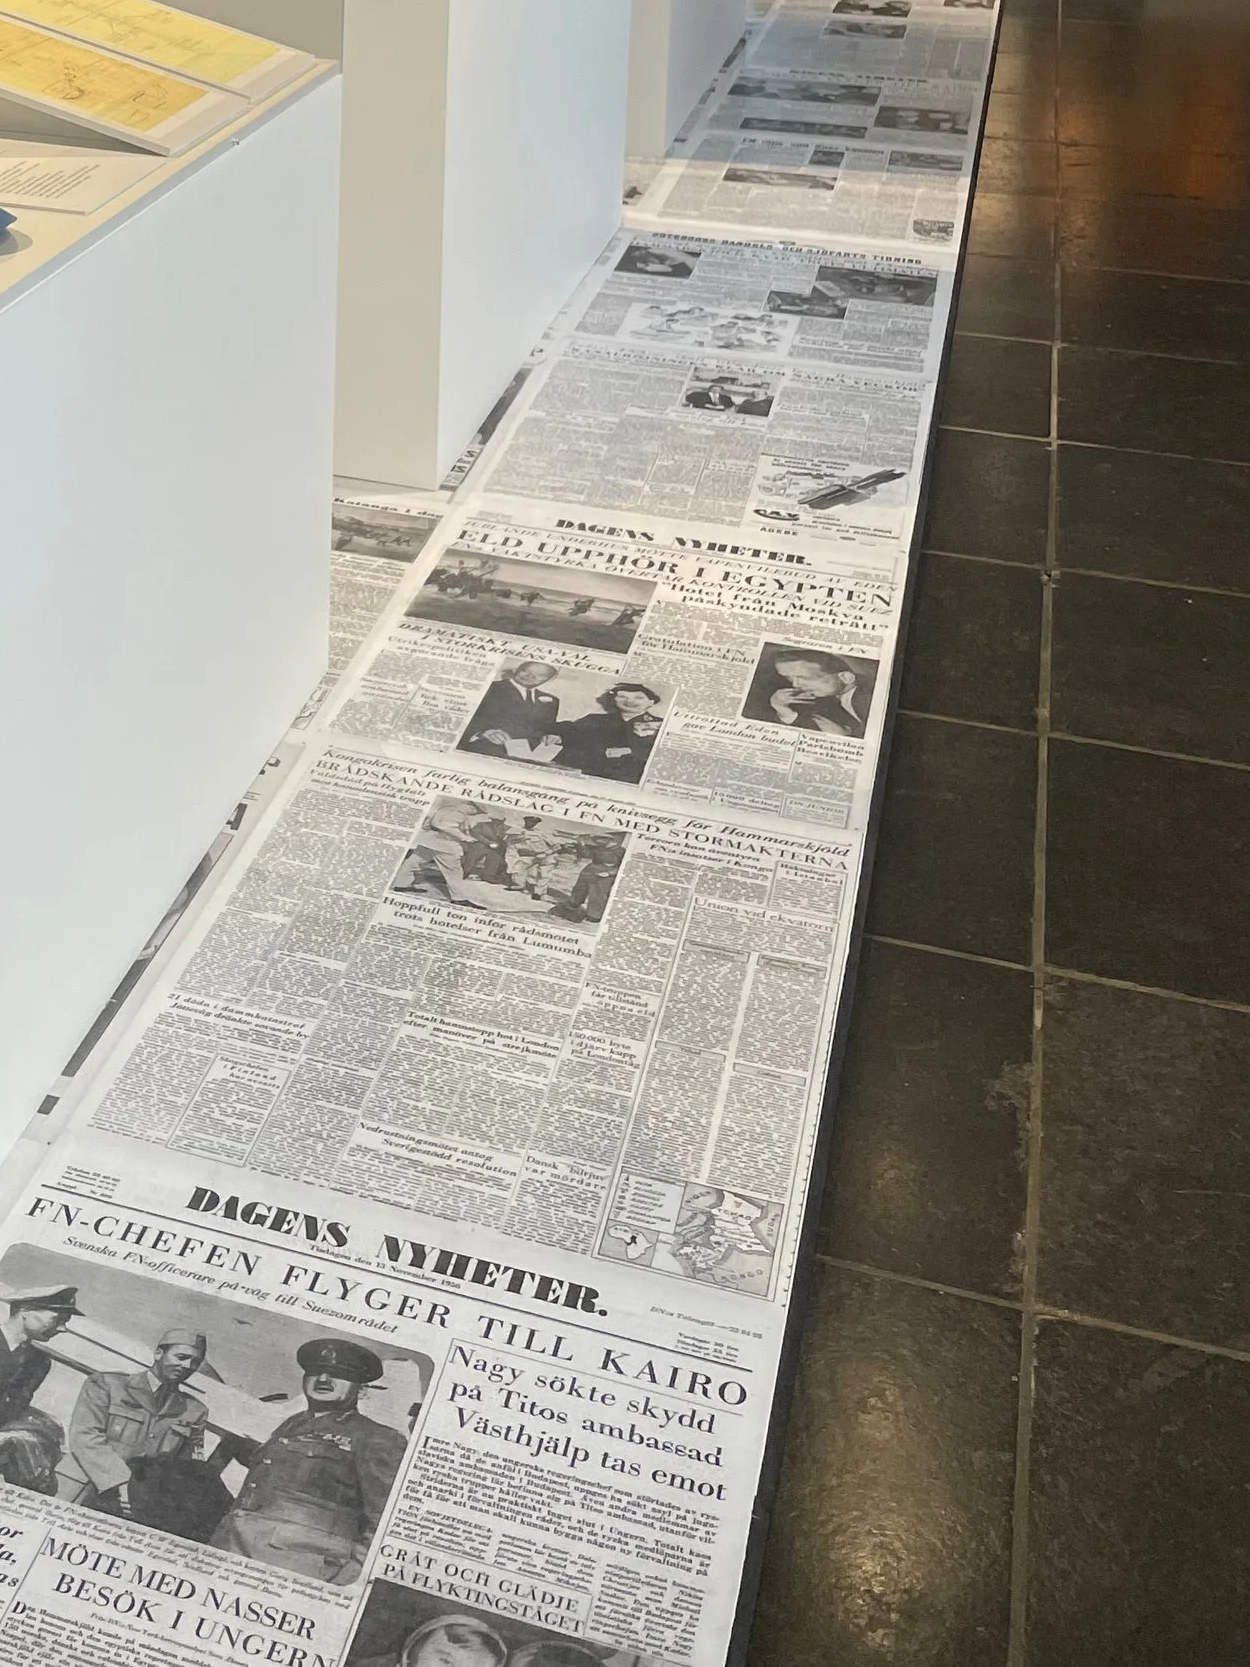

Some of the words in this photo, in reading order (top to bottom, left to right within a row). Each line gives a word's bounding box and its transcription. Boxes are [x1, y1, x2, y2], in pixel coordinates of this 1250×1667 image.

[458, 529, 524, 548] ELD
[537, 540, 679, 574] UPPHÖR
[696, 567, 705, 578] I
[722, 570, 892, 608] EGYPTEN
[554, 519, 655, 542] DAGENS
[671, 536, 812, 566] NYHETER.
[682, 595, 801, 619] påskyndade
[733, 593, 776, 607] från
[788, 601, 865, 622] Moskva
[321, 749, 417, 775] Kongokrisen
[423, 768, 472, 786] farlig
[478, 779, 570, 804] balansgång
[575, 800, 598, 811] på
[607, 802, 679, 827] knivsegg
[685, 819, 712, 833] för
[719, 824, 851, 859] Hammarskjöld
[460, 784, 554, 814] RÅDSLAG
[561, 807, 570, 816] I
[579, 811, 606, 822] FN
[615, 818, 660, 834] MED
[669, 829, 848, 871] STORMAKTERNA
[382, 896, 446, 915] Hoppfull
[447, 911, 468, 922] ton
[474, 916, 507, 930] inför
[512, 923, 580, 945] rådsmötet
[394, 910, 423, 923] trots
[429, 916, 484, 935] hotelser
[487, 929, 516, 943] från
[523, 936, 593, 959] Lumumba
[694, 896, 739, 914] Union
[744, 909, 766, 920] vid
[770, 913, 835, 933] ekvatorn
[403, 1019, 428, 1029] efter
[432, 1025, 477, 1041] manöver
[482, 1038, 495, 1047] på
[408, 1011, 439, 1024] Totalt
[496, 1031, 513, 1042] hot
[521, 1037, 560, 1051] London
[456, 1157, 517, 1178] resolution
[460, 1147, 495, 1163] antog
[63, 1236, 118, 1258] Svenska
[123, 1250, 217, 1285] FN-officerare
[274, 1293, 299, 1308] till
[302, 1300, 400, 1334] Suezområdet
[185, 1185, 351, 1248] DAGENS
[375, 1234, 608, 1318] NYHETER.
[354, 1255, 372, 1266] den
[375, 1261, 386, 1269] 13
[390, 1264, 437, 1284] November
[25, 1196, 263, 1276] FN-CHEFEN
[279, 1263, 451, 1329] FLYGER
[477, 1315, 574, 1361] TILL
[598, 1346, 748, 1406] KAIRO
[447, 1381, 483, 1404] på
[498, 1387, 569, 1424] Titos
[581, 1417, 724, 1467] ambassad
[448, 1345, 526, 1386] Nagy
[535, 1374, 617, 1408] sökte
[626, 1397, 716, 1435] skydd
[421, 1436, 450, 1449] Imre
[482, 1450, 499, 1460] den
[502, 1456, 545, 1475] ungerske
[613, 1488, 633, 1499] som
[636, 1494, 682, 1512] störtades
[454, 1406, 590, 1469] Västhjälp
[599, 1450, 642, 1478] tas
[651, 1469, 728, 1502] emot
[40, 1537, 127, 1579] MÖTE
[130, 1563, 197, 1601] MED
[200, 1587, 317, 1641] NASSER
[52, 1571, 162, 1623] BESÖK
[168, 1610, 187, 1631] I
[379, 1543, 437, 1571] GRÅT
[444, 1562, 491, 1586] OCH
[498, 1577, 580, 1614] GLÄDJE
[382, 1561, 407, 1582] PÅ
[411, 1572, 586, 1635] FLYKTINGSTÅGET
